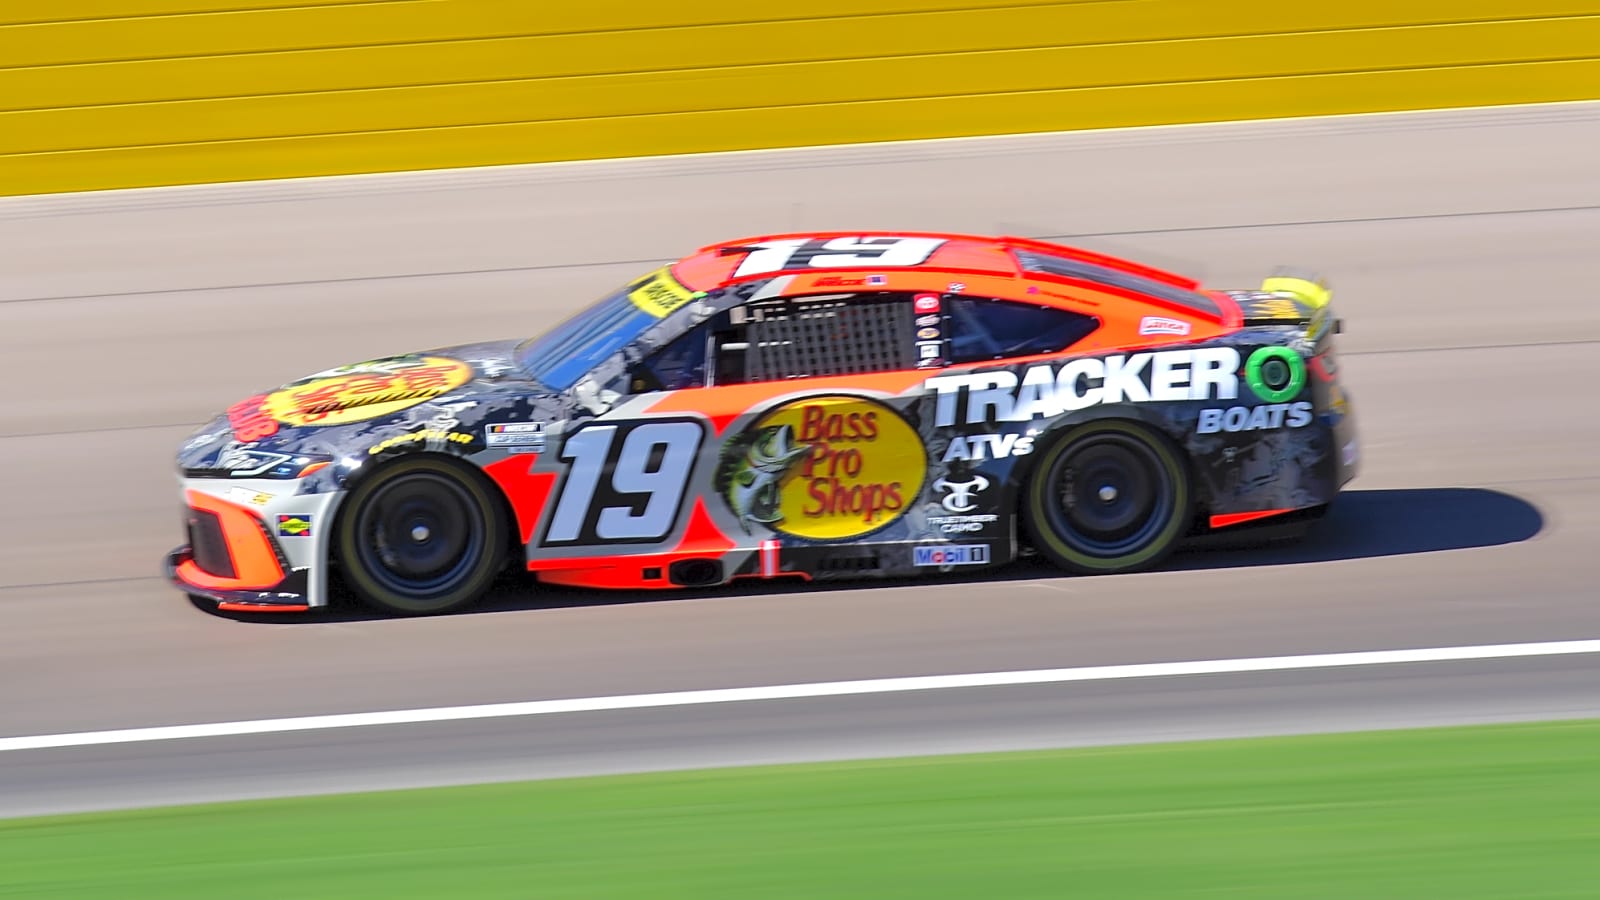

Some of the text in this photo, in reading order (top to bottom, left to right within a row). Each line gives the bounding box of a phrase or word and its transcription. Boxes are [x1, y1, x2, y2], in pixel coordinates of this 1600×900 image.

[732, 236, 950, 278] 19
[924, 346, 1240, 427] TRACKER
[227, 394, 280, 443] CLUB
[796, 405, 878, 442] Bass
[1196, 401, 1313, 434] BOATS
[800, 442, 863, 478] Pro
[941, 433, 1035, 463] ATVs
[545, 421, 704, 543] 19
[803, 476, 904, 524] Shops
[940, 522, 984, 534] CAMO
[917, 546, 964, 564] Mobil
